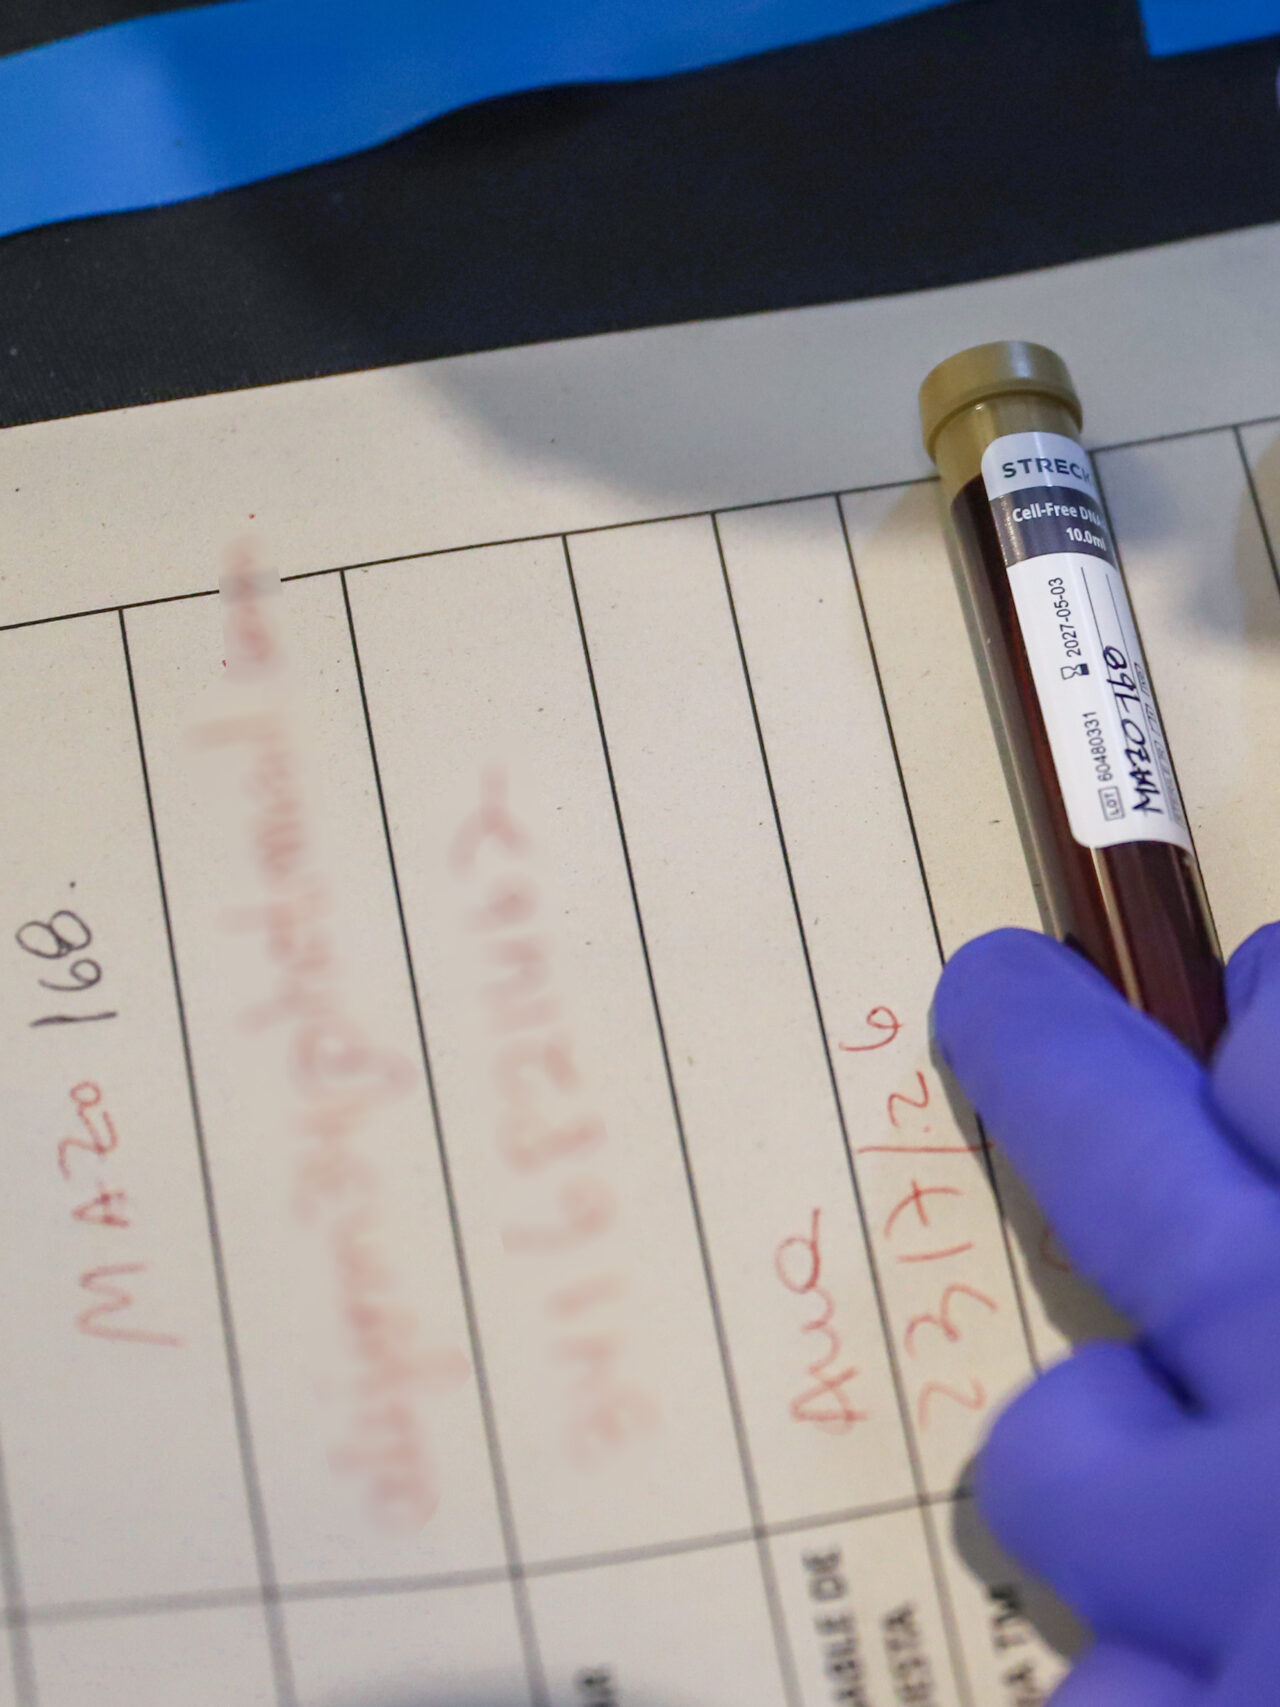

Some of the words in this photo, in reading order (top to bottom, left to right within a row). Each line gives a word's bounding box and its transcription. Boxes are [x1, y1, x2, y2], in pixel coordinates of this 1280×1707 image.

[1012, 502, 1078, 523] Cell-Free
[1048, 577, 1081, 658] 2027-05-03
[1084, 710, 1110, 782] 60480331
[1103, 790, 1121, 818] LOT
